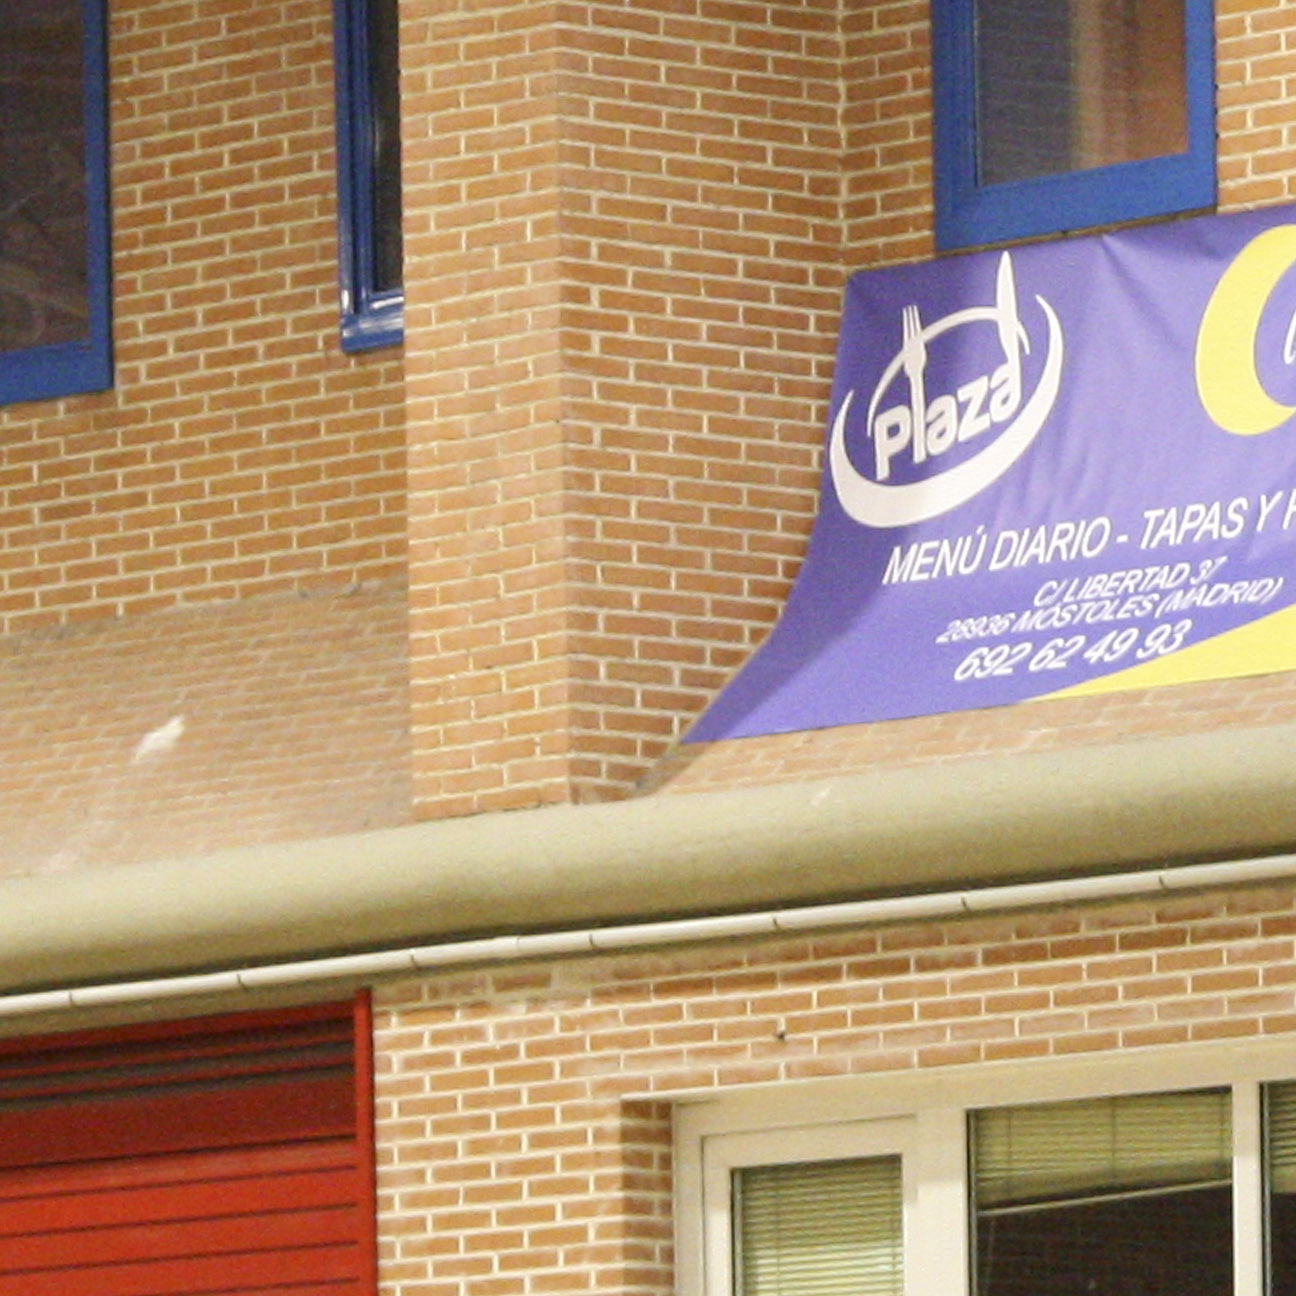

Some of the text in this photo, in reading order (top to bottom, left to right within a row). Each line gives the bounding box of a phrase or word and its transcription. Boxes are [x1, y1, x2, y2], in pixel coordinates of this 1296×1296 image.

[881, 524, 988, 586] MENÚ
[988, 516, 1112, 572] DIARIO
[1140, 496, 1249, 550] TAPAS
[1256, 491, 1283, 533] Y
[1153, 576, 1285, 619] (MADRID)
[953, 618, 1194, 682] 692 62 49 93
